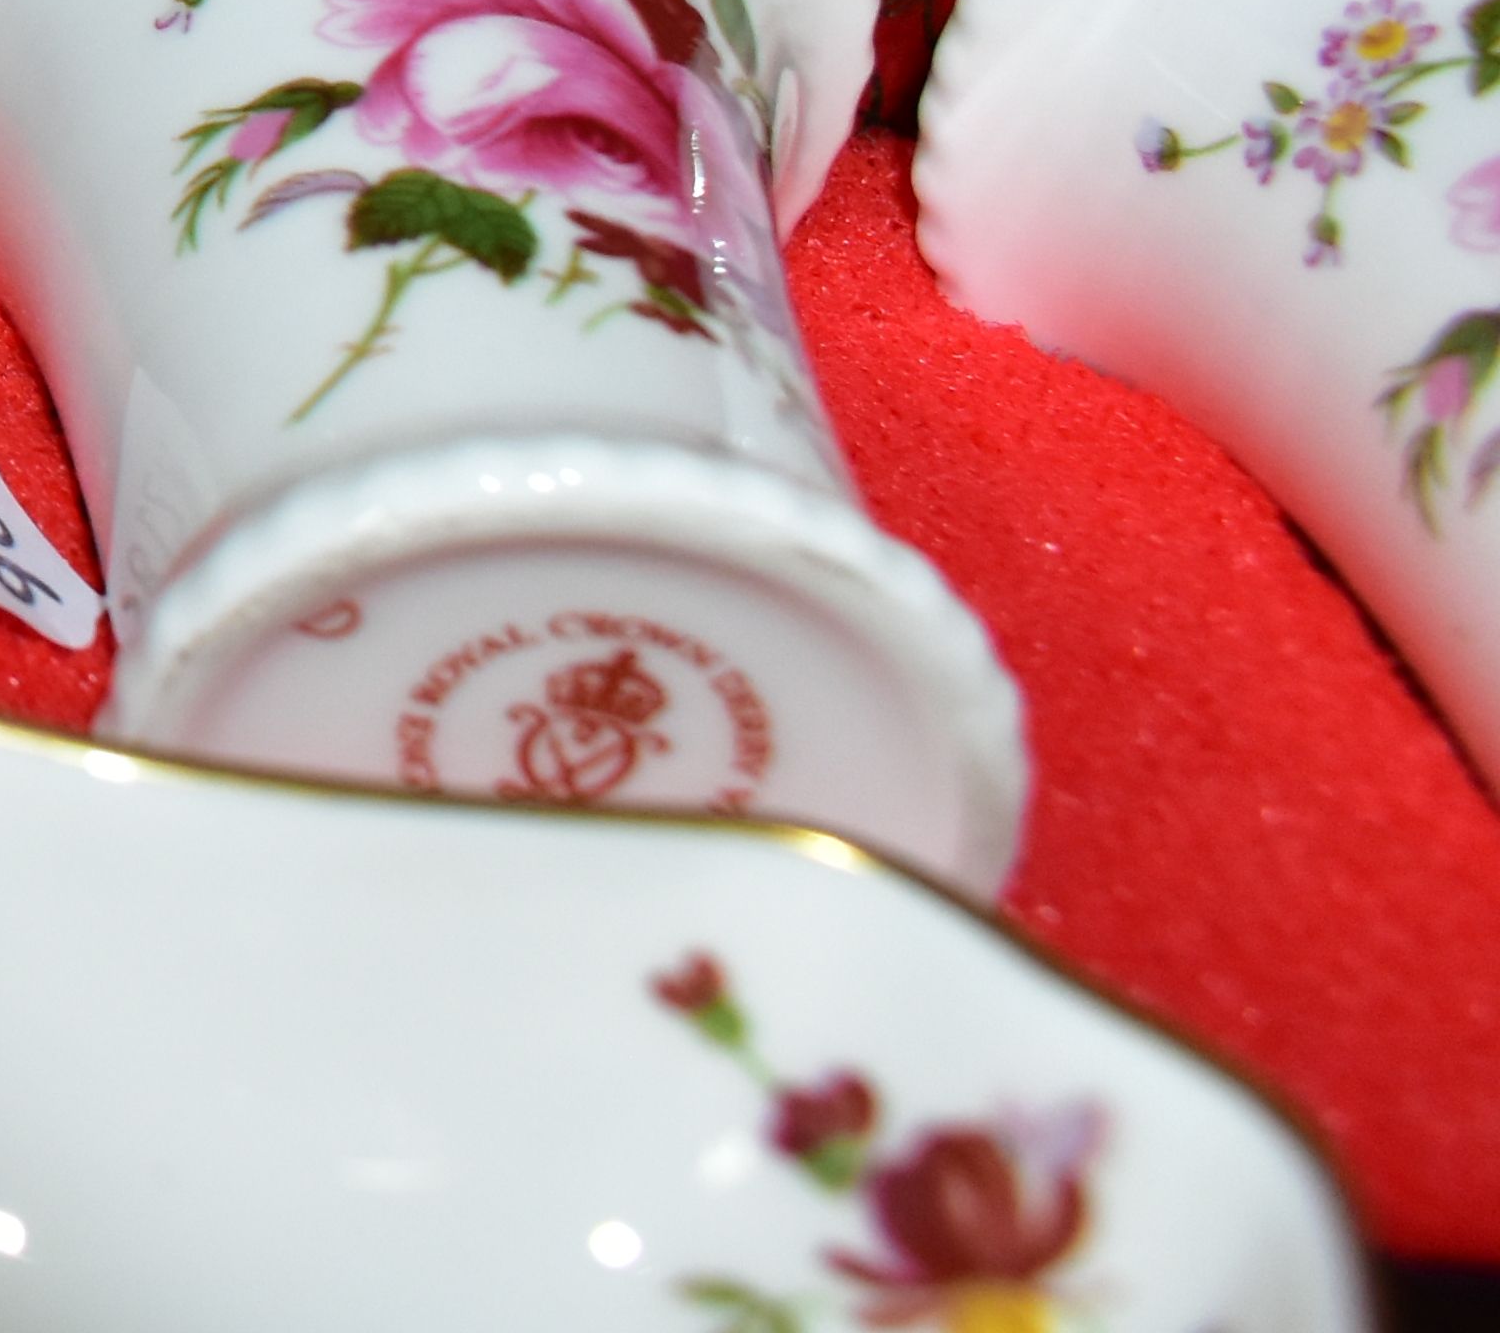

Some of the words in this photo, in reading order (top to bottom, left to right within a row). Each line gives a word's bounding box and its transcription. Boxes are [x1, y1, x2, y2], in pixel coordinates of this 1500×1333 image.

[410, 622, 537, 707] ROYAL
[549, 610, 717, 669] CROWN
[711, 668, 770, 779] DERBY
